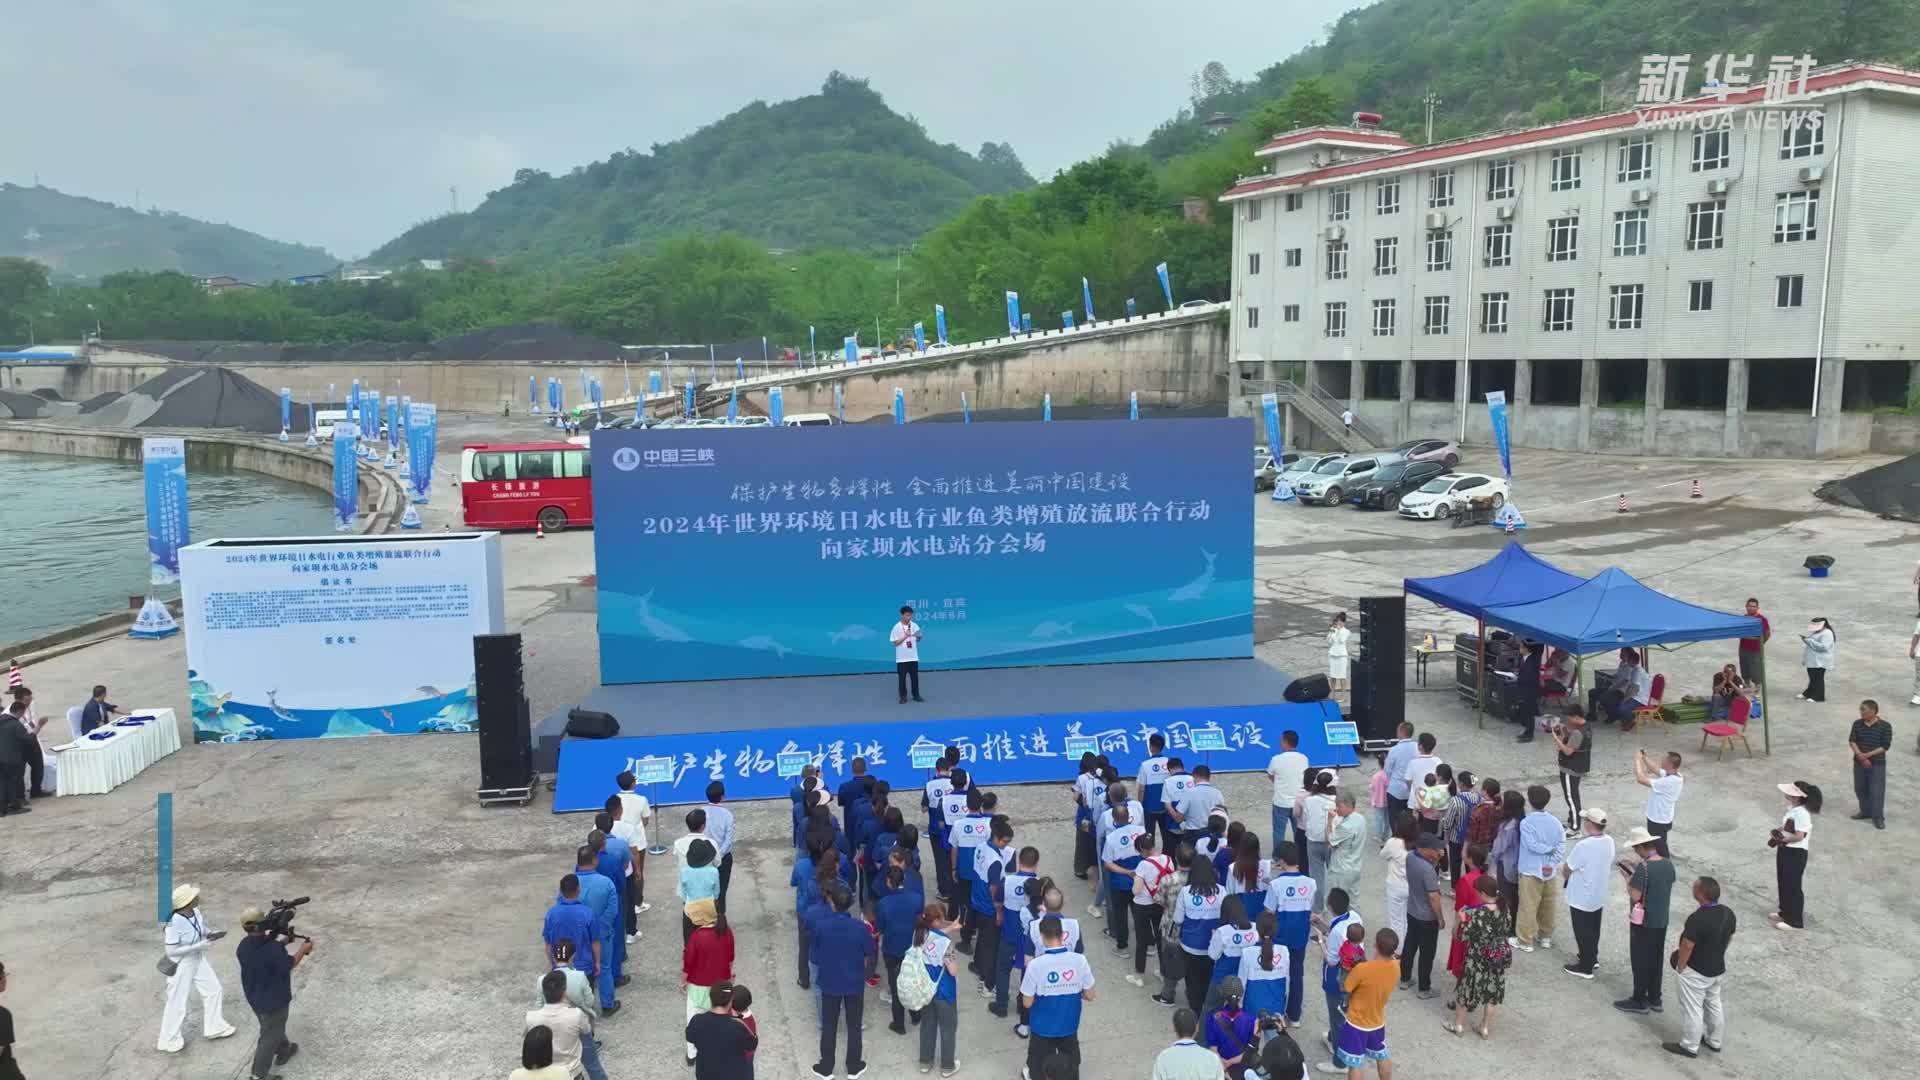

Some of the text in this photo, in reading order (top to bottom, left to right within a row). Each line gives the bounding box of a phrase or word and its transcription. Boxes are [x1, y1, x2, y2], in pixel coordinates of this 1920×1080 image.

[644, 448, 715, 463] 中国三峡
[731, 470, 1131, 503] 保护生物多样性 全面推进美丽中国建设
[643, 499, 1211, 536] 2024年世界环境日水电行业鱼类增殖放流联合行动
[820, 533, 1047, 560] 向家坝水电站分会场
[911, 611, 966, 622] 024年6月
